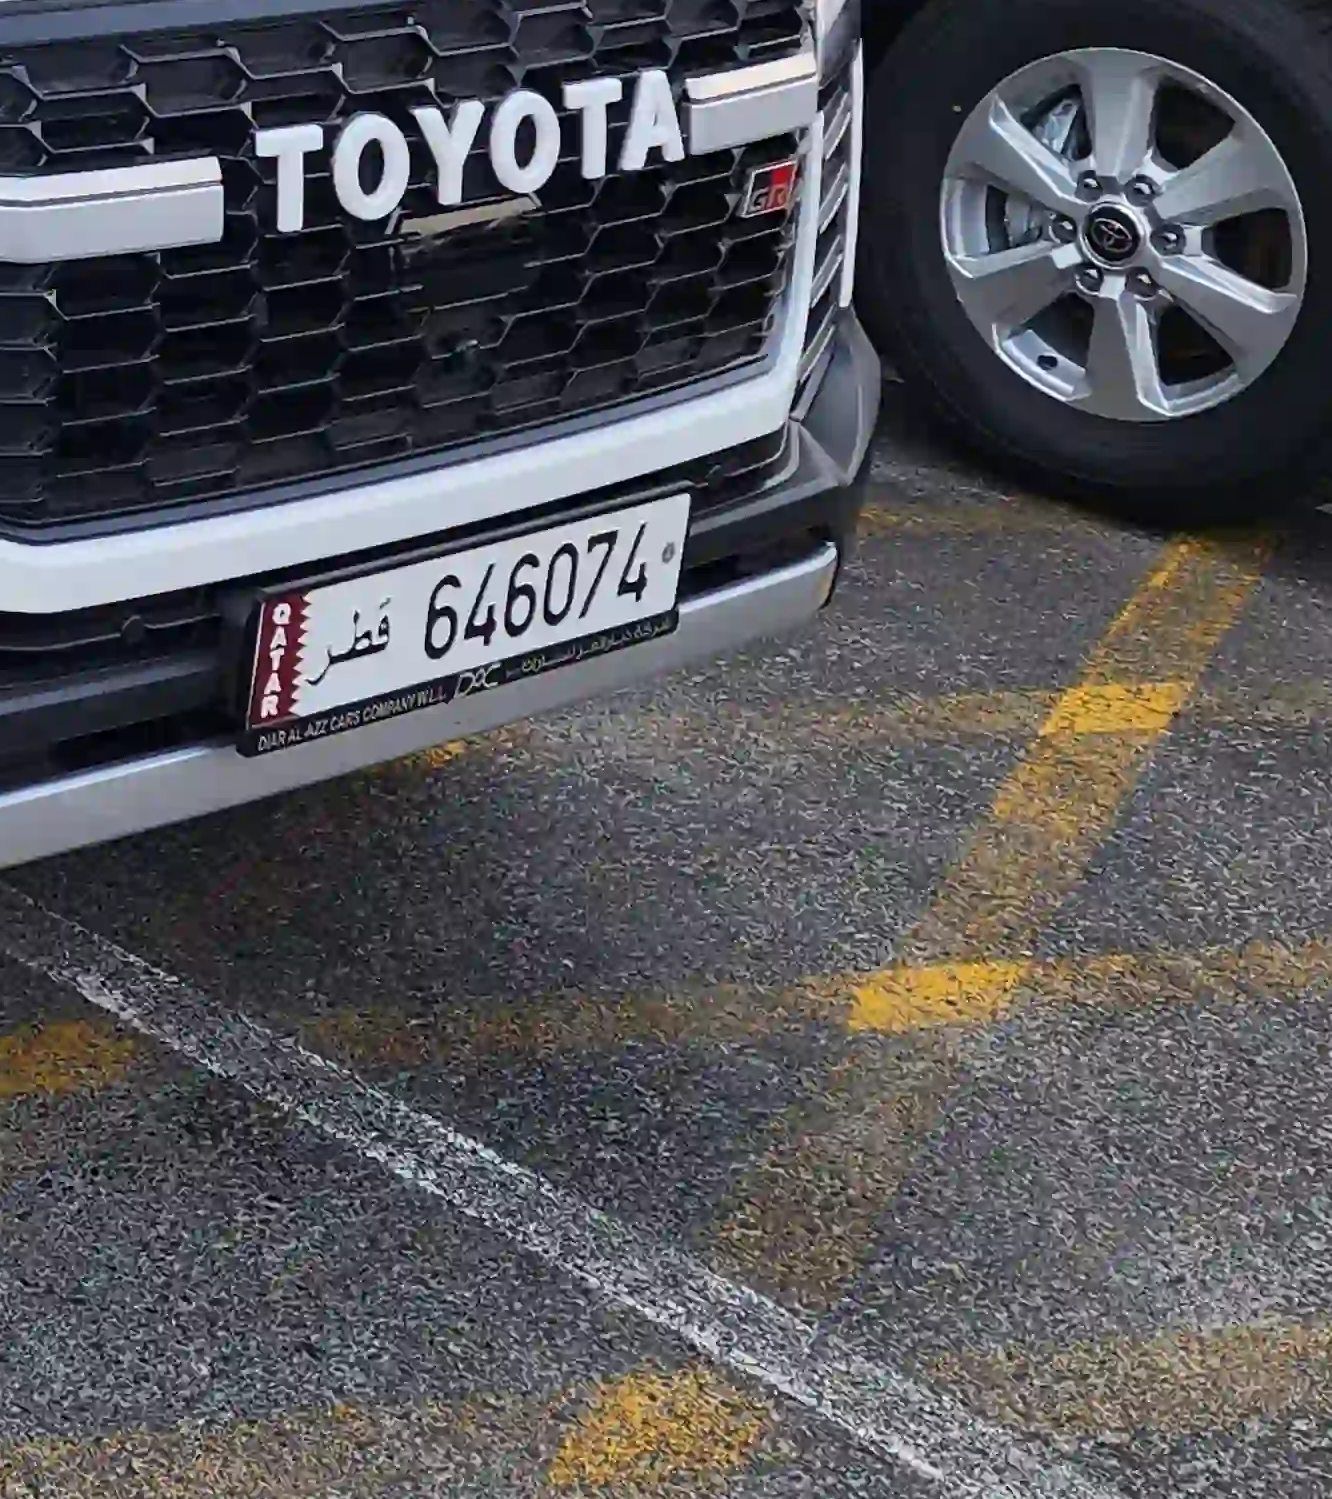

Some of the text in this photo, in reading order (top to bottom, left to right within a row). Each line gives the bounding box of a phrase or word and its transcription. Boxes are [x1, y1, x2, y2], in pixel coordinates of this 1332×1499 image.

[254, 69, 686, 233] TOYOTA
[305, 596, 392, 686] قطر
[423, 522, 647, 660] 646074
[260, 602, 291, 719] QATAR
[362, 691, 417, 721] COMPANY
